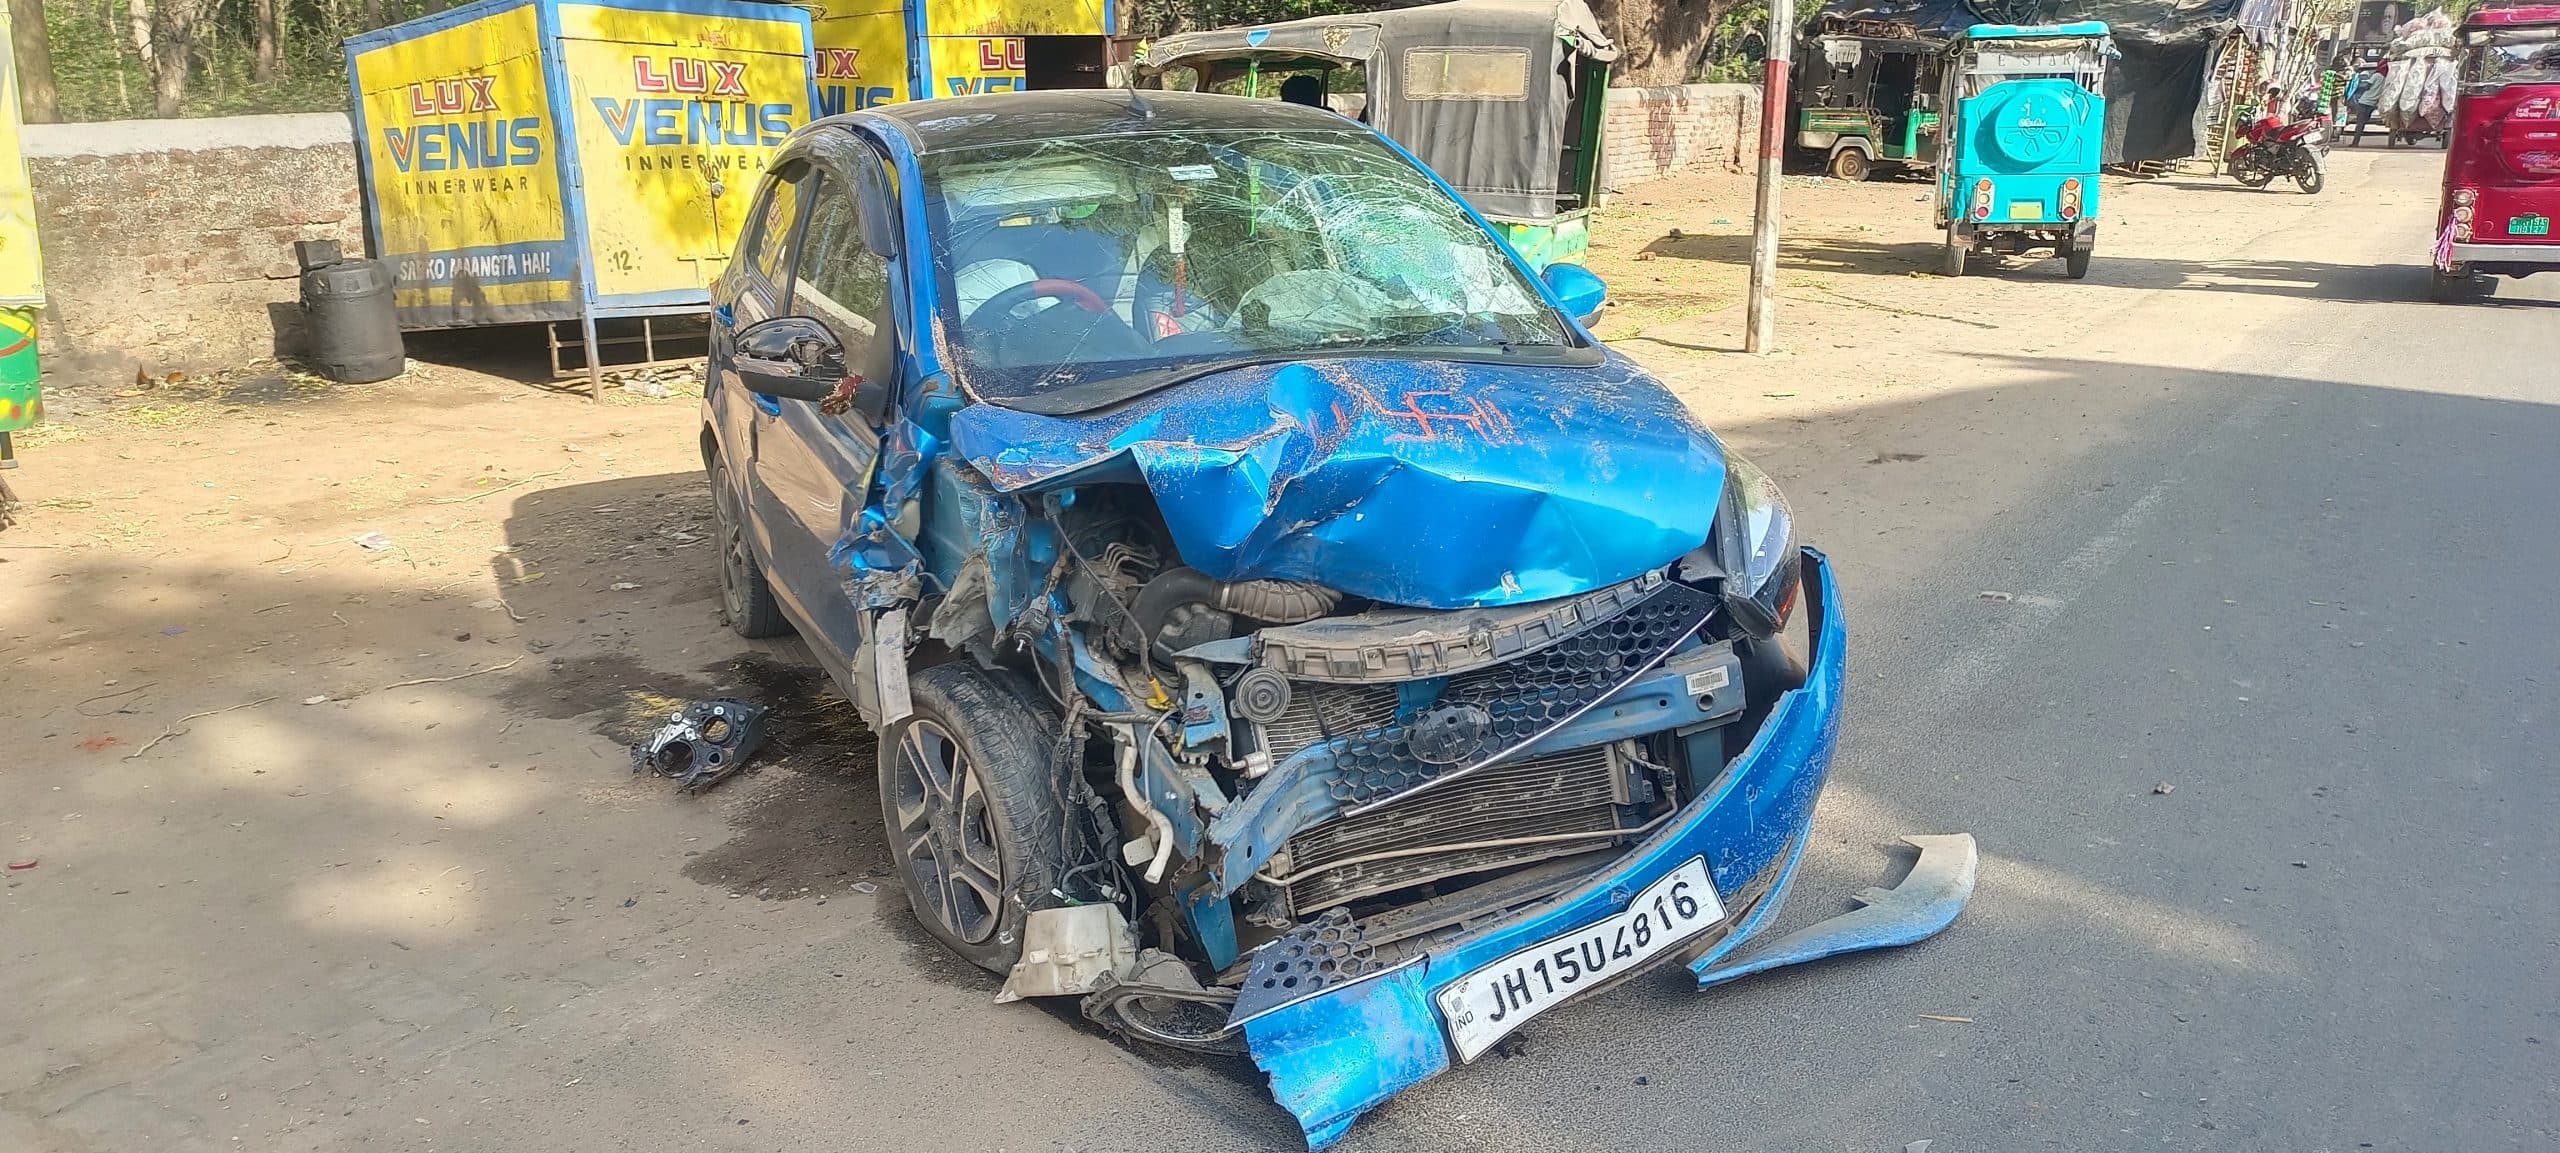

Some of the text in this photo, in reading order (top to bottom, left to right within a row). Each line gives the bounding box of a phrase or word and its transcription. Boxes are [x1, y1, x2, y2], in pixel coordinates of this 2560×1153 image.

[633, 55, 747, 97] LUX
[410, 75, 500, 118] LUX
[590, 97, 793, 146] VENUS
[384, 117, 541, 172] VENUS
[626, 155, 765, 170] INNERWEA
[405, 176, 528, 195] INNERWEAR
[522, 251, 550, 275] HAI!
[613, 250, 632, 270] 12
[1490, 881, 1698, 1022] JH15U4816
[1455, 1010, 1474, 1031] IND
